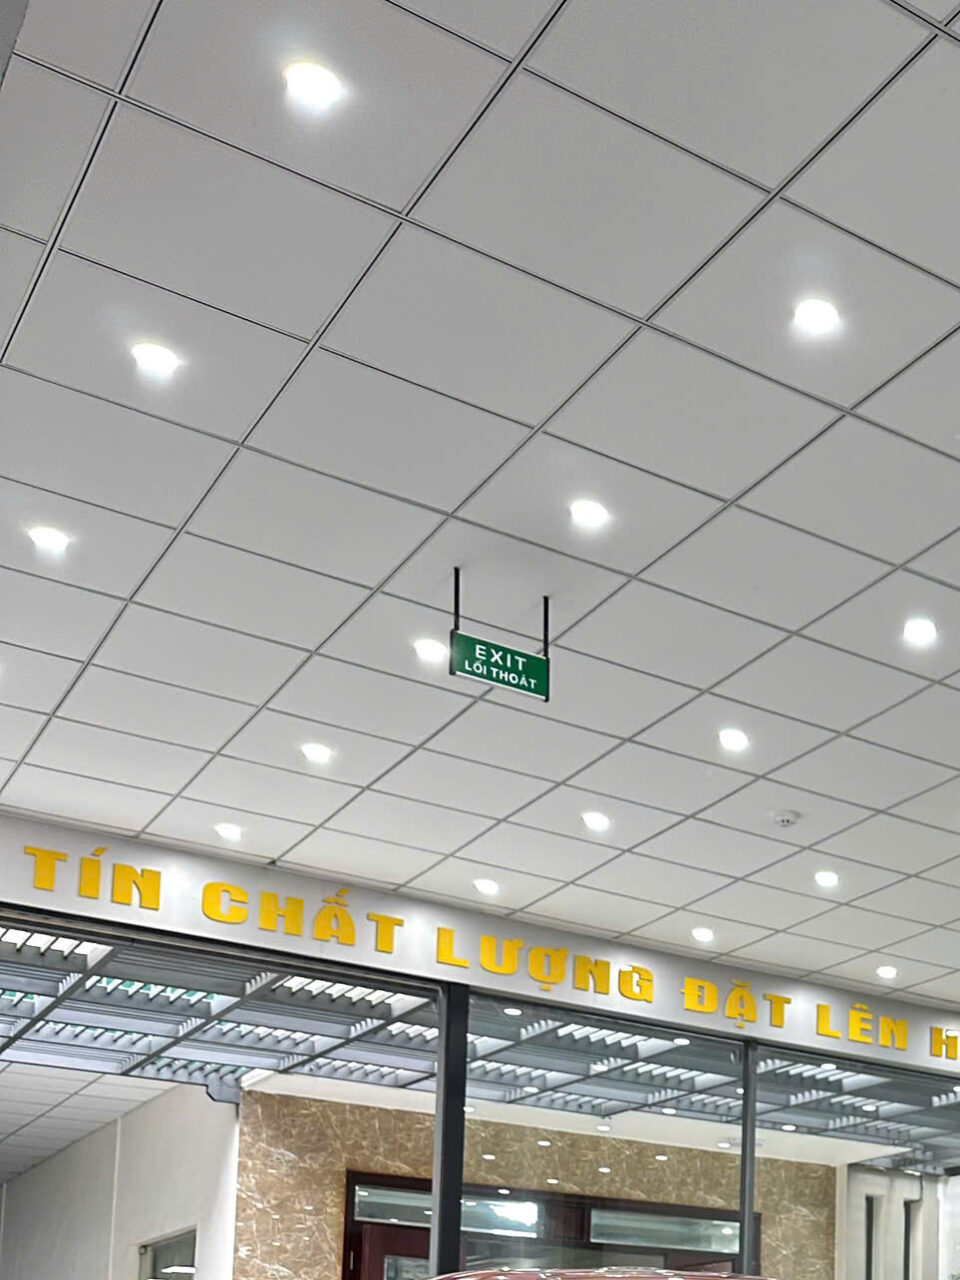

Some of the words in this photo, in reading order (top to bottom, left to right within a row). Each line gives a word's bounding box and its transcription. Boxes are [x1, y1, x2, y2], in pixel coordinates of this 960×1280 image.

[475, 644, 527, 671] EXIT
[24, 846, 161, 911] TÍN
[202, 882, 404, 953] CHẤT
[436, 926, 655, 1003] LƯỢNG
[680, 977, 792, 1028] ĐẶT
[817, 1003, 908, 1051] LÊN
